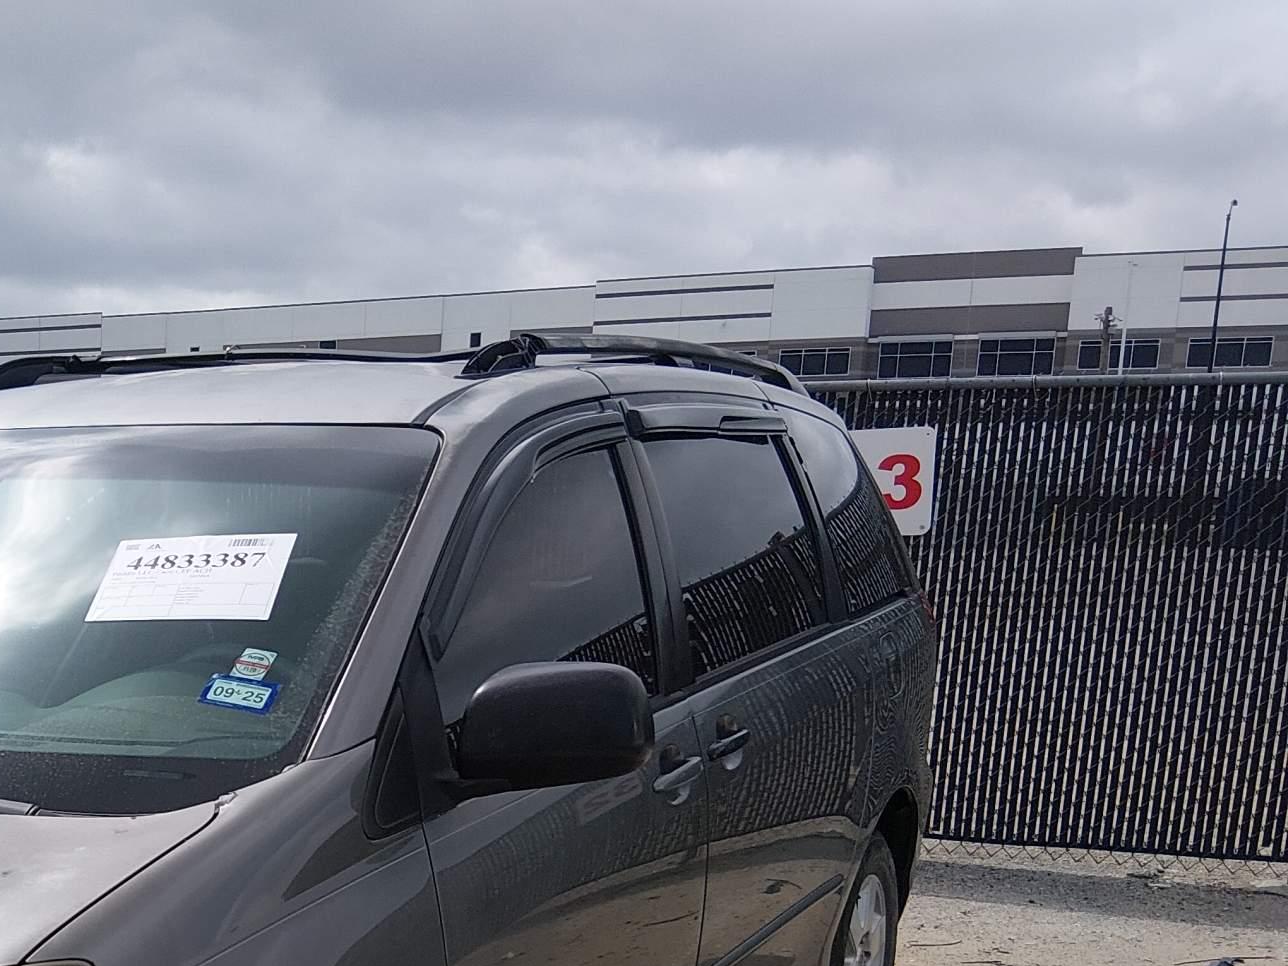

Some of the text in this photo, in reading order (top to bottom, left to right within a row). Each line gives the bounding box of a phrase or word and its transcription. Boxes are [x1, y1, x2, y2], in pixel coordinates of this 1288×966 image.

[878, 454, 922, 510] 3
[127, 552, 266, 570] 44833387
[213, 686, 235, 698] 09
[241, 691, 266, 704] 25
